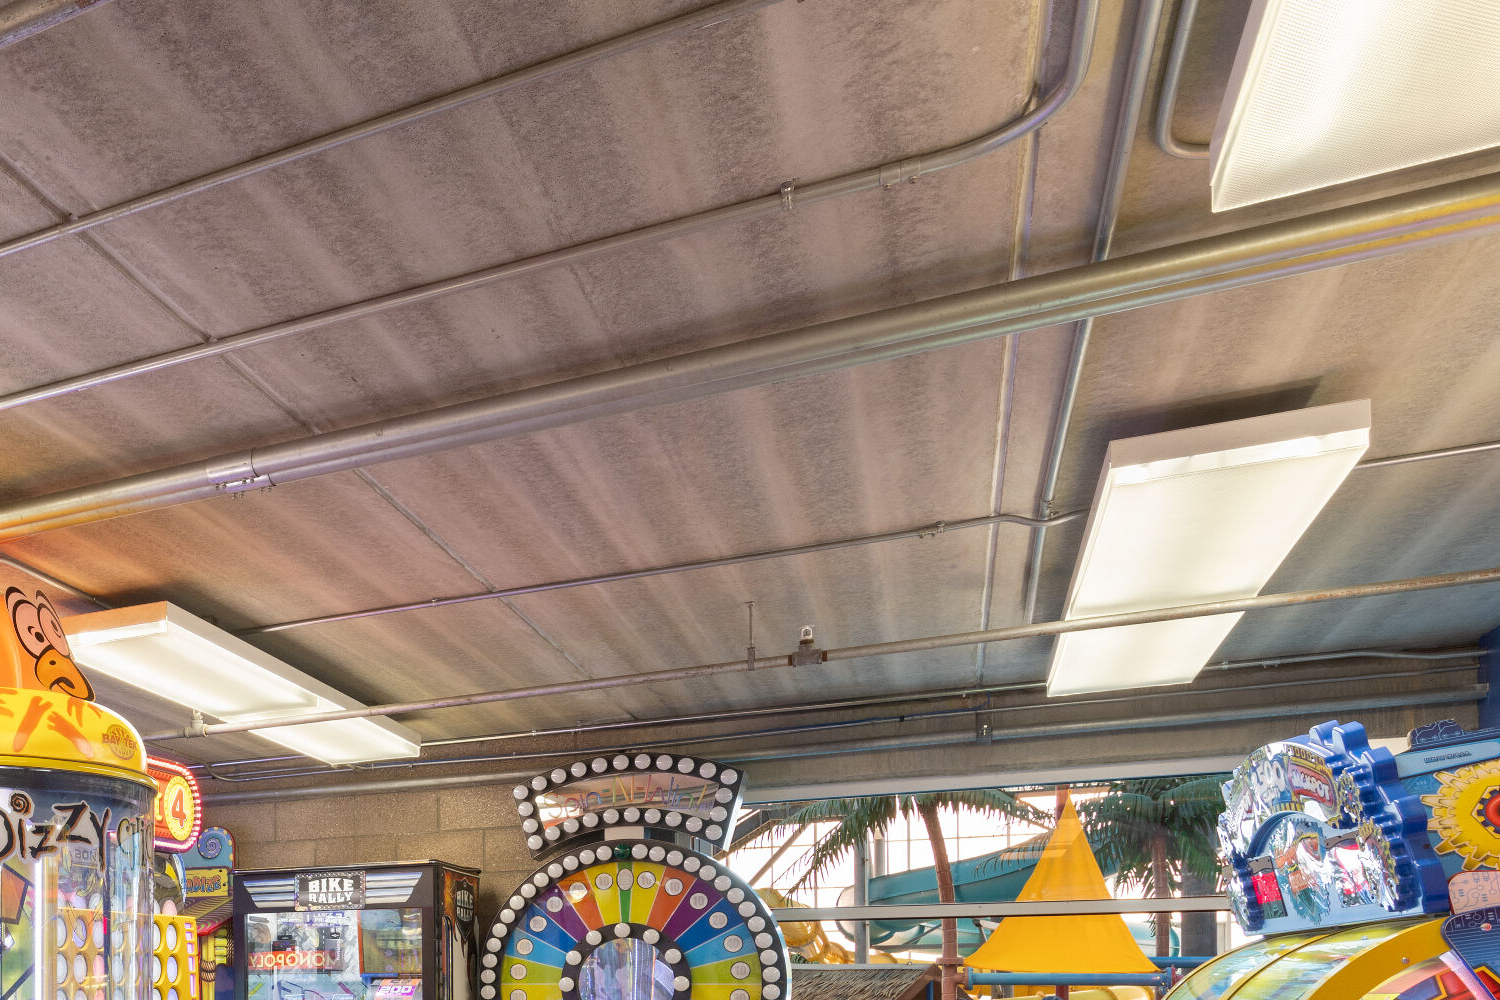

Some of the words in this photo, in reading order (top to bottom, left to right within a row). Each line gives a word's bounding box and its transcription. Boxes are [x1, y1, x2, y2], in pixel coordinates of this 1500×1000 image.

[102, 733, 121, 745] BAY
[123, 737, 138, 751] TEK
[172, 787, 187, 828] 4
[186, 875, 221, 894] ADIZE
[308, 877, 354, 892] BIKE
[308, 891, 353, 903] RALLY
[456, 890, 474, 905] BIKE
[693, 896, 705, 906] 10
[456, 907, 474, 922] RALLY
